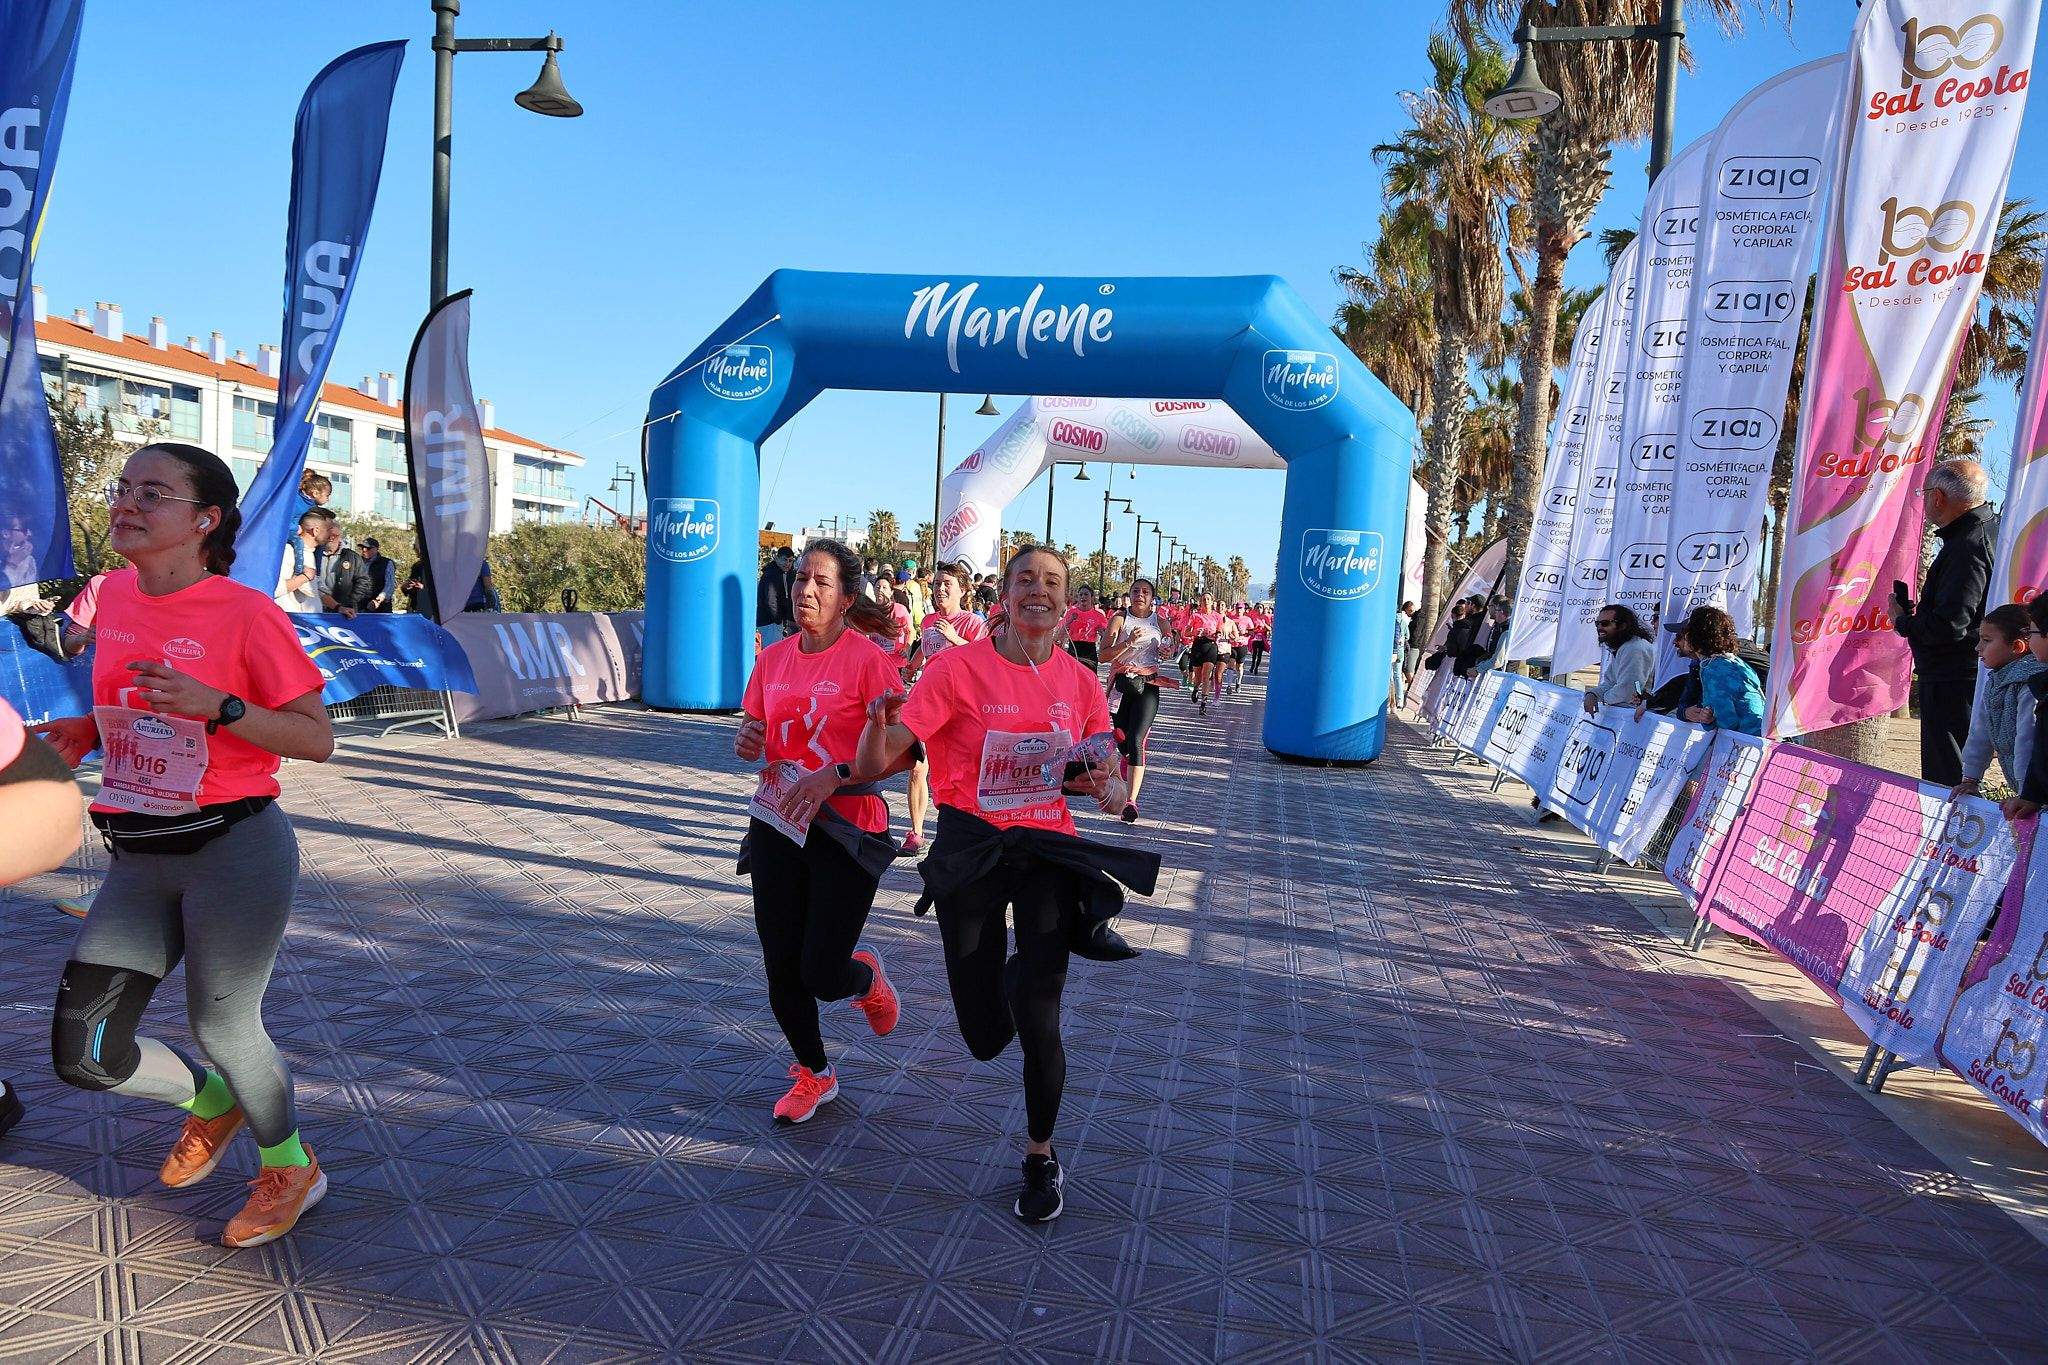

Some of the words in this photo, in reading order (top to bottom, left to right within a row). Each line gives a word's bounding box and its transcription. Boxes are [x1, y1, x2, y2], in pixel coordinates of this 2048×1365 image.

[1867, 83, 1924, 120] Sal
[1934, 64, 2029, 108] Costa
[1896, 117, 1949, 134] Desde
[1958, 104, 1995, 122] 1925
[1732, 224, 1797, 234] CORPORAL
[1733, 238, 1740, 247] Y
[1743, 237, 1793, 247] CAPILAR
[1841, 261, 1897, 293] Sal
[1869, 295, 1922, 308] Desde
[904, 281, 1113, 374] Marlene
[1701, 334, 1763, 347] OSMÉTICA
[708, 355, 768, 384] Marlene
[1718, 364, 1727, 373] Y
[1268, 363, 1334, 394] Marlene
[1654, 382, 1681, 391] CORP
[744, 385, 763, 397] ALPES
[1308, 393, 1328, 407] ALPES
[1052, 421, 1103, 450] COSMO
[1183, 427, 1236, 456] COSMO
[422, 403, 473, 517] IMR
[1815, 451, 1872, 479] Sal
[1625, 480, 1673, 492] COSMÉTIC
[1641, 494, 1670, 503] CORP
[654, 512, 715, 544] Marlene
[939, 505, 978, 548] COSMO
[1305, 544, 1377, 580] Marlene
[1534, 571, 1565, 590] ziaj
[1581, 567, 1608, 580] zia
[1307, 576, 1321, 590] HIJA
[1321, 586, 1332, 594] DE
[1333, 588, 1348, 596] LOS
[1348, 582, 1370, 595] ALPES
[1615, 589, 1663, 600] COSMÉTIC
[100, 628, 135, 644] OYSHO
[493, 621, 587, 680] IMR
[982, 704, 1020, 714] OYSHO
[134, 722, 174, 737] ASTURIANA
[1015, 744, 1047, 753] ASTURIANA
[133, 753, 168, 775] 016
[1011, 764, 1041, 779] 016
[109, 791, 135, 805] OYSHO
[987, 797, 1014, 807] OYSHO
[150, 802, 184, 812] Santander
[1032, 808, 1062, 820] MUJER
[1776, 935, 1834, 983] MOMENTOS
[2005, 972, 2033, 1000] Sal
[1967, 1058, 1991, 1089] Sal
[1991, 1075, 2032, 1116] Costa
